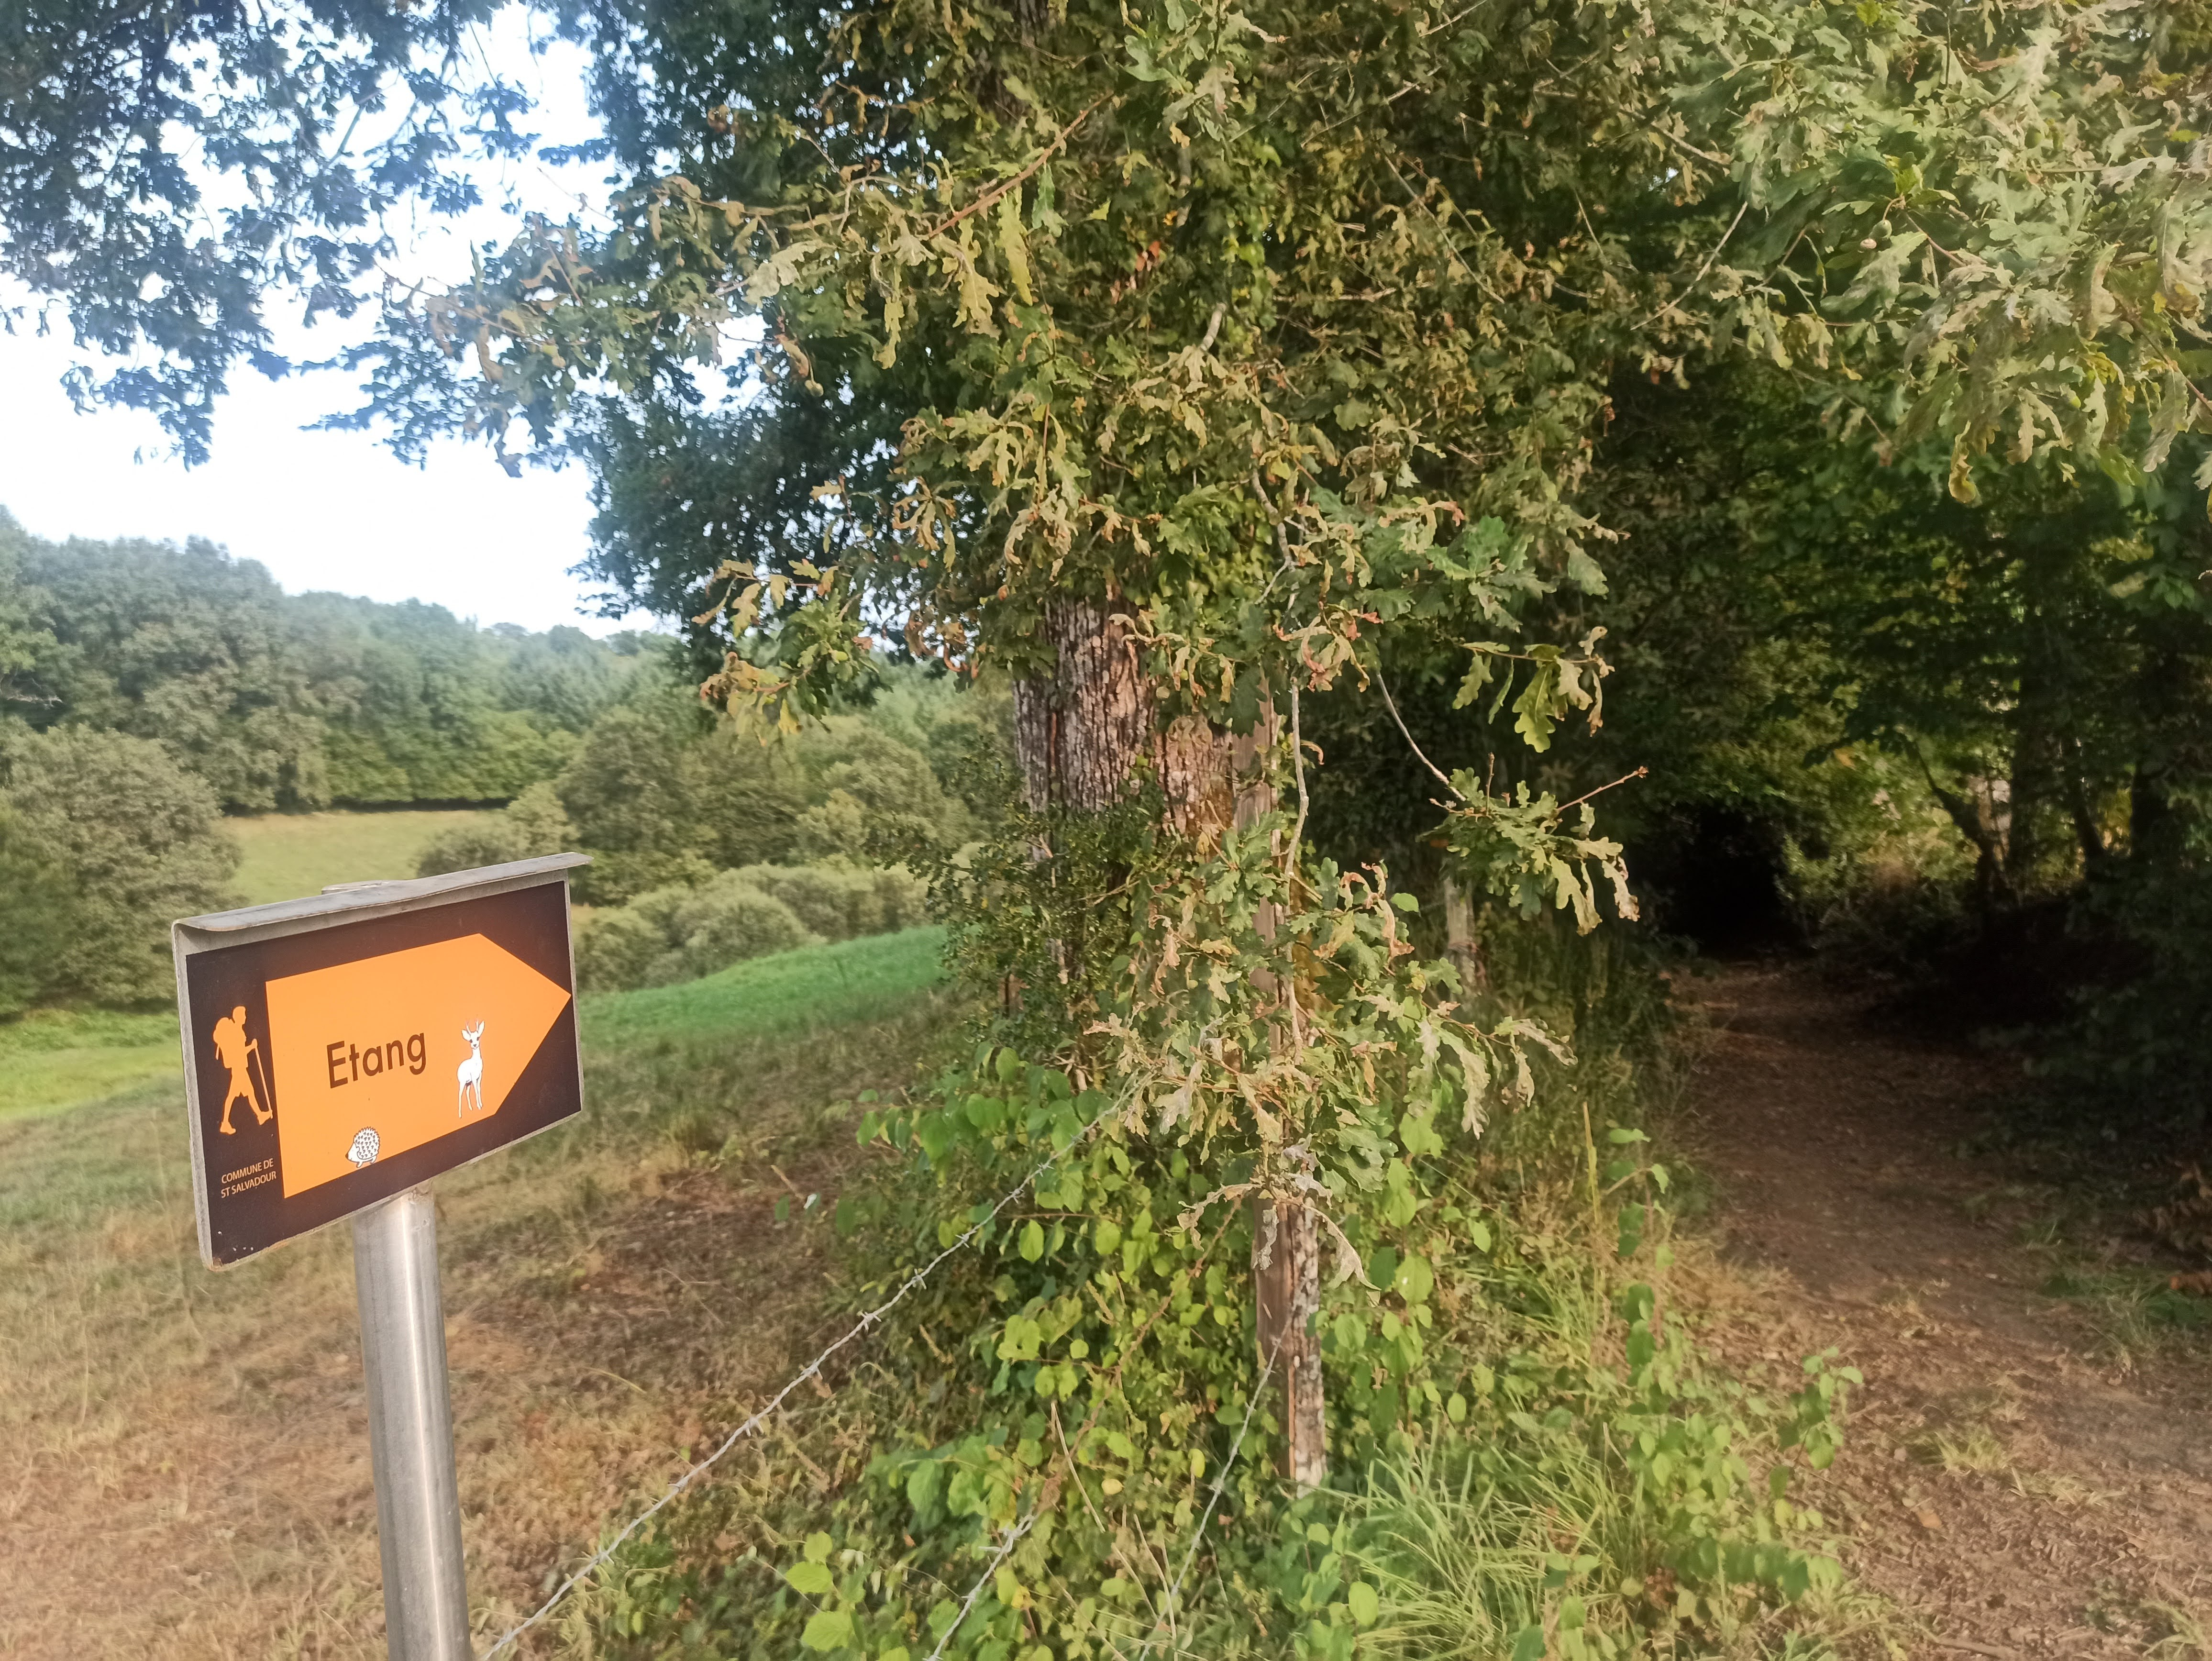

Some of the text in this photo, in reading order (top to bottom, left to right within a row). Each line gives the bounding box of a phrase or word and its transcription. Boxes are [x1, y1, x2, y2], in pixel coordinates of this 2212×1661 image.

[327, 1032, 426, 1089] Etang
[221, 1158, 274, 1184] COMMUNE DE
[221, 1171, 276, 1198] ST SALVADOUR
